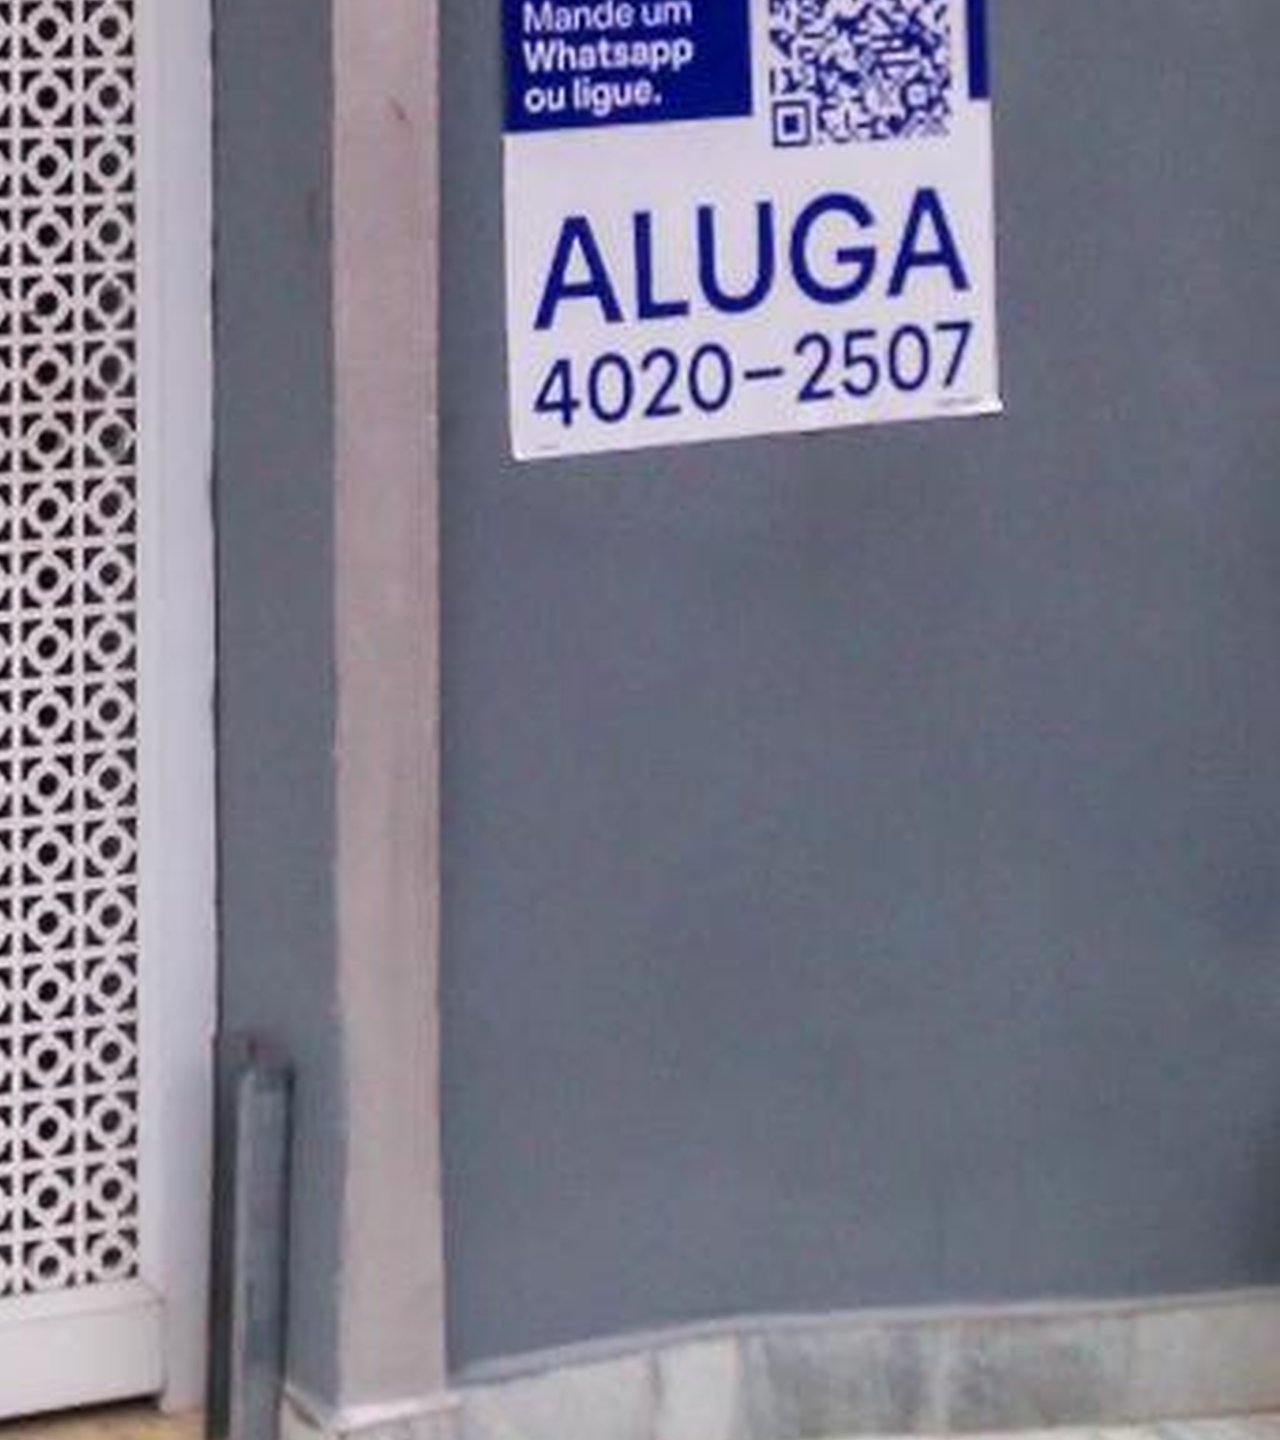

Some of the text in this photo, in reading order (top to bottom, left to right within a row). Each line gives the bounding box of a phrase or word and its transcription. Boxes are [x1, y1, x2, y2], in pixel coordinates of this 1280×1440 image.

[523, 0, 693, 34] Mande um
[522, 36, 694, 73] Whatsapp
[524, 76, 663, 118] ou ligue.
[533, 186, 971, 331] ALUGA
[533, 320, 973, 428] 4020-2507
